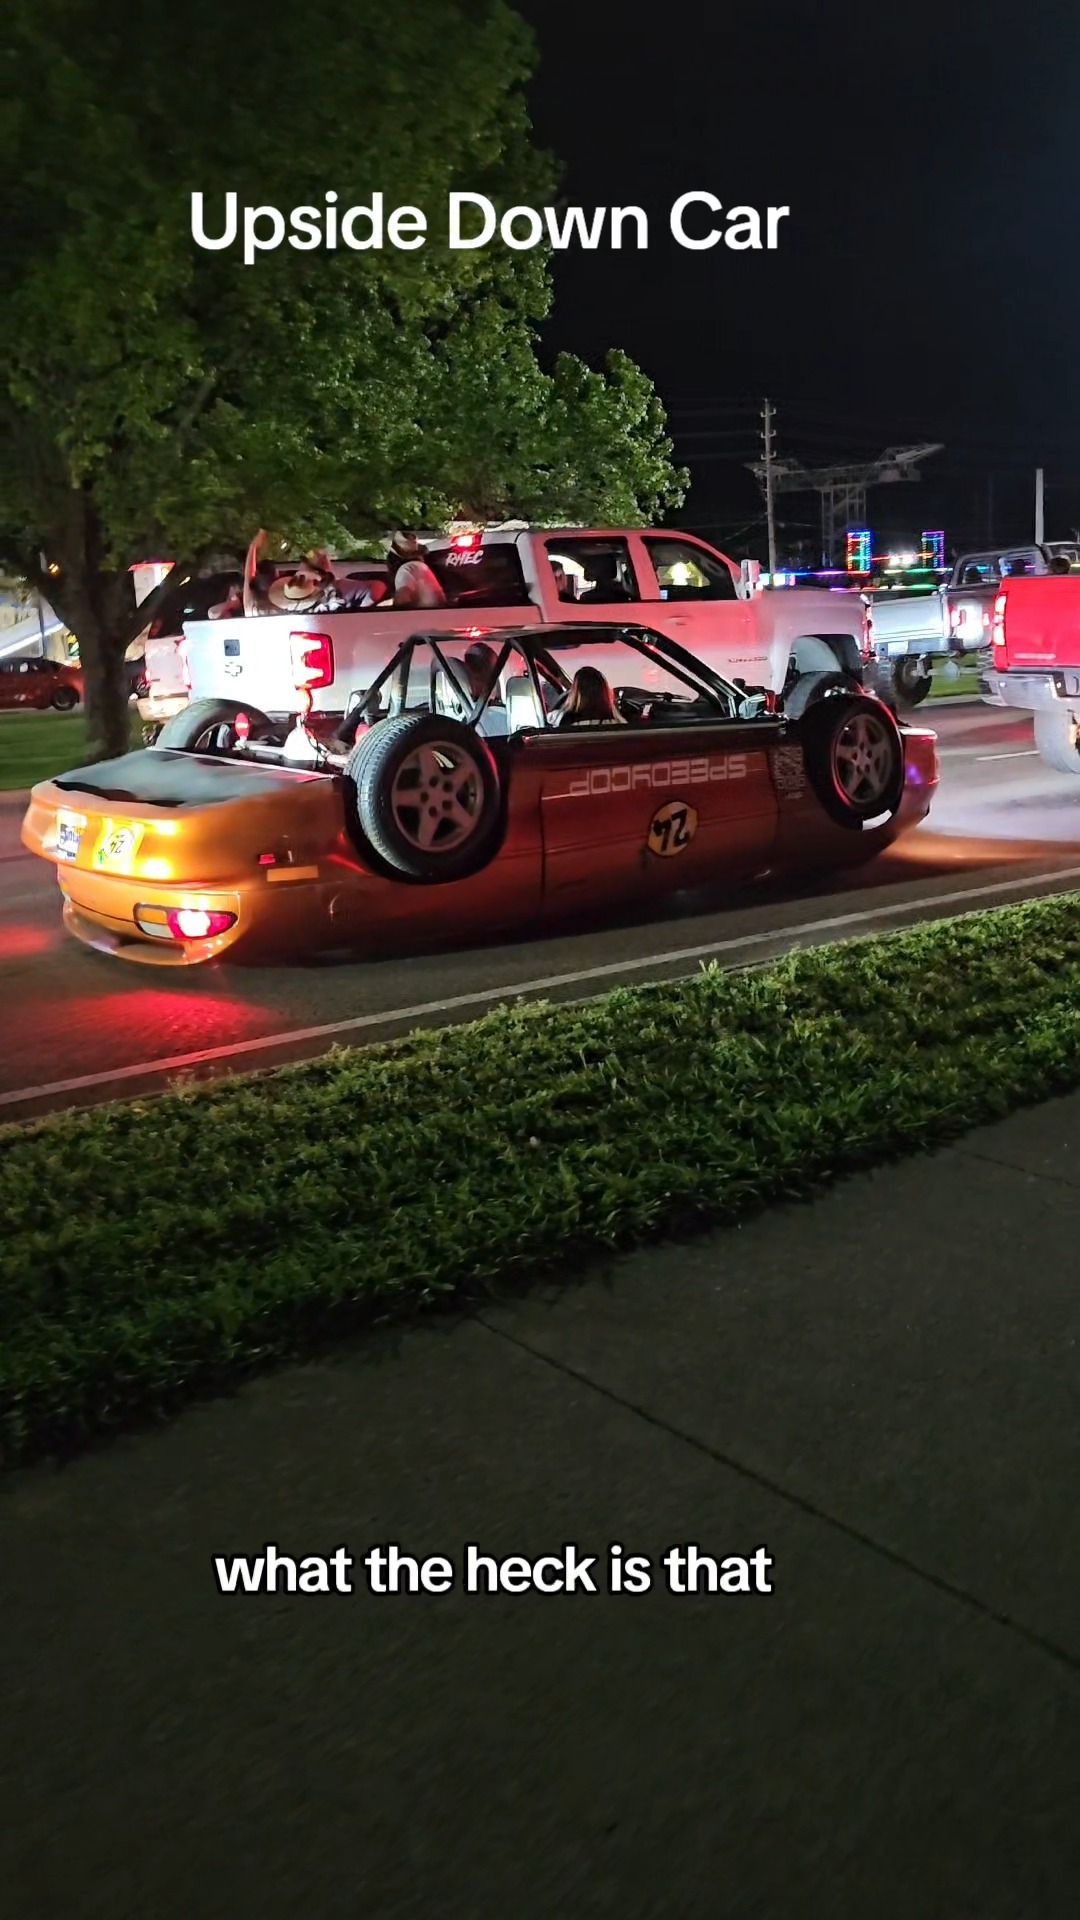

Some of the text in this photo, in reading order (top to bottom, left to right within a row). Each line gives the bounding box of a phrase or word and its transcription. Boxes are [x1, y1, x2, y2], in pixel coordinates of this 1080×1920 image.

[445, 550, 484, 567] RHEC
[569, 755, 748, 797] SPEEDYCOP
[652, 808, 690, 852] 24
